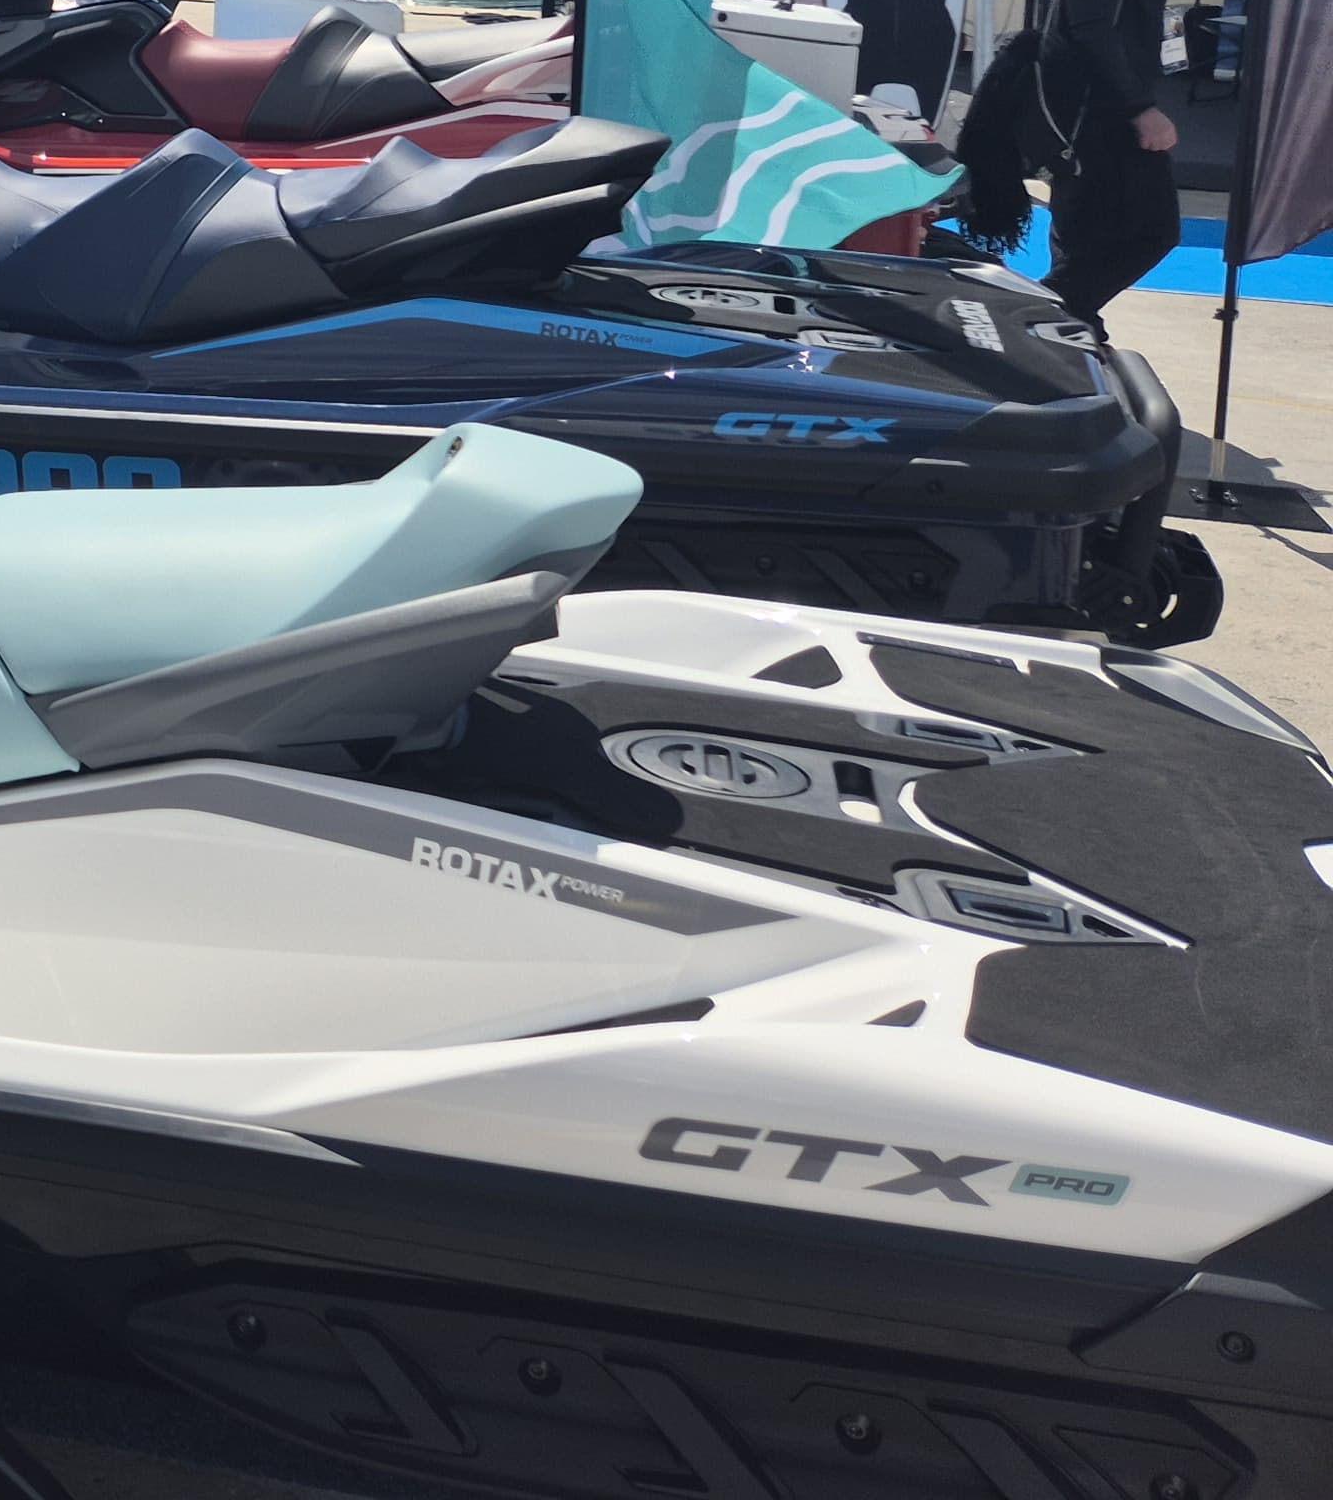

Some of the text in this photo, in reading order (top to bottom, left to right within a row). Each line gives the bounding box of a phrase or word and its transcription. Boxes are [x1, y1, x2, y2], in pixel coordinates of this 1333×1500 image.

[540, 321, 618, 348] ROTAX
[711, 411, 901, 444] GTX
[411, 836, 626, 904] ROTAX POWER
[639, 1115, 1122, 1208] GTX PRO
